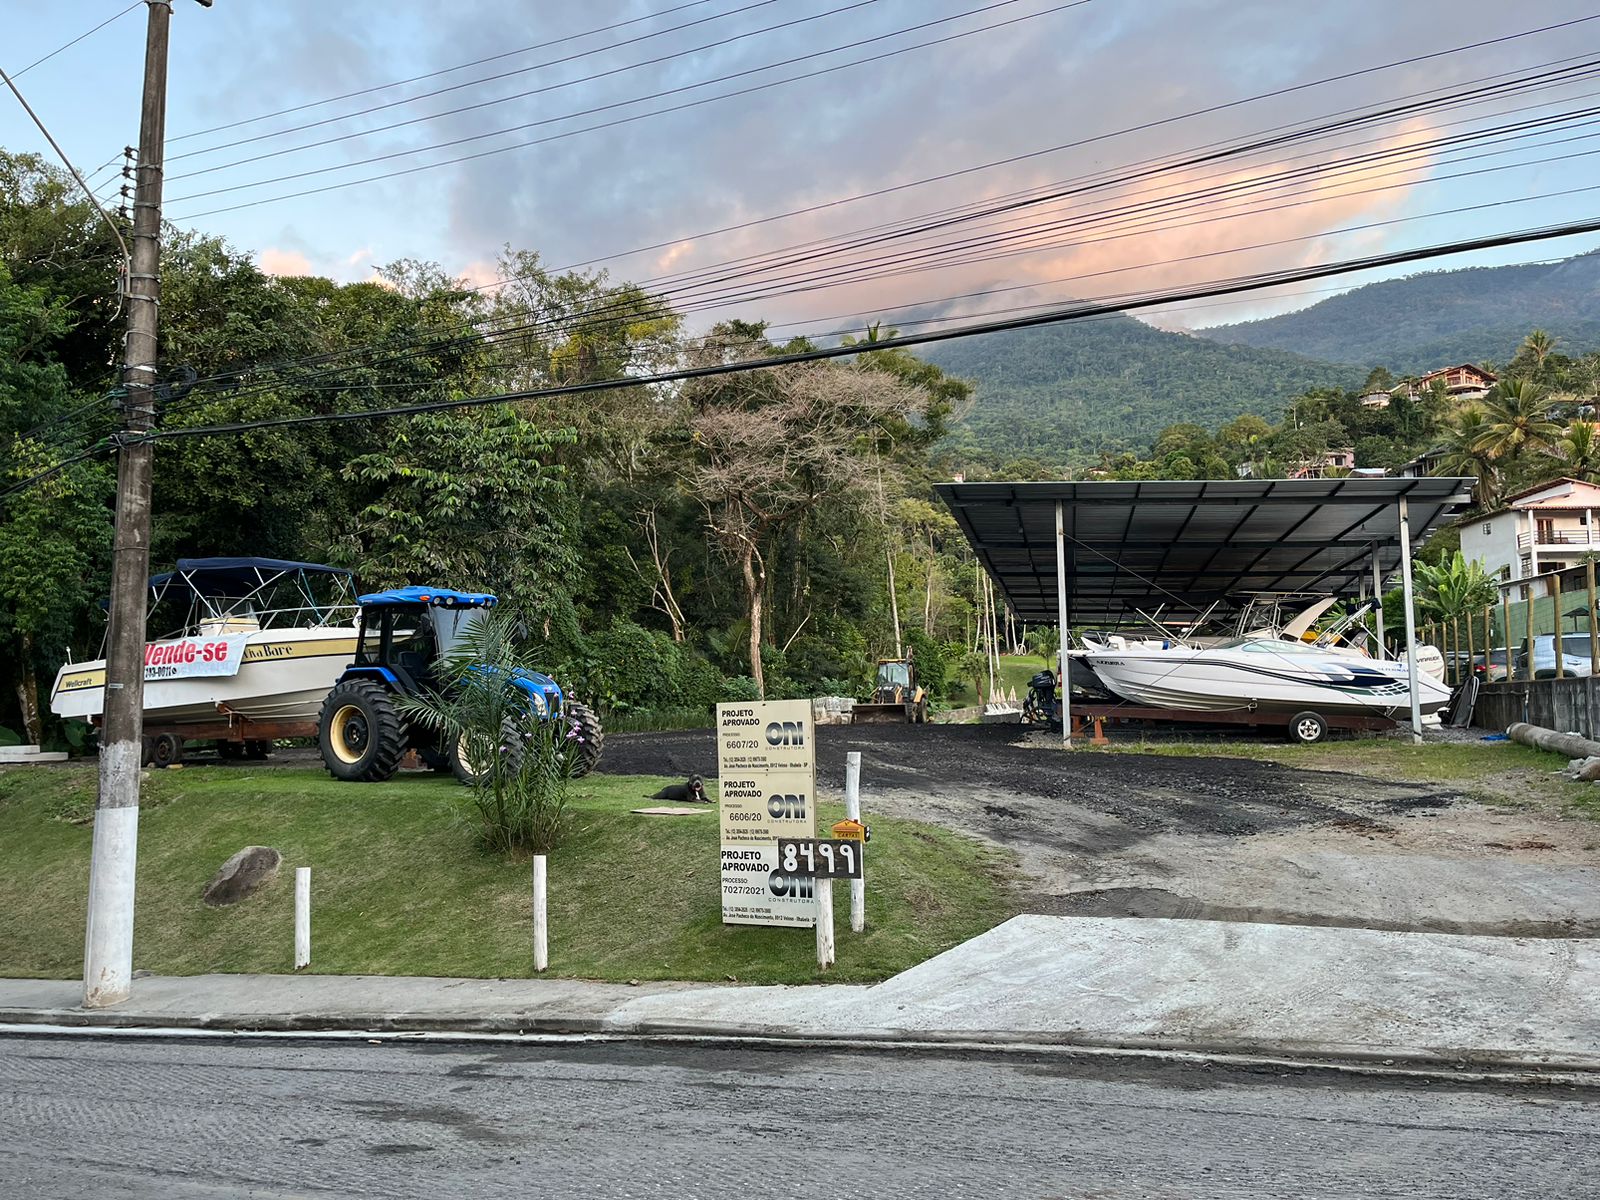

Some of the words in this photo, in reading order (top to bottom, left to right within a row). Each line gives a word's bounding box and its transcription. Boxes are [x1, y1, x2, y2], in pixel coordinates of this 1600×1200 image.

[145, 641, 228, 666] Vende-se
[65, 678, 92, 688] Wellcraft
[722, 710, 754, 718] PROJETO
[722, 718, 760, 727] APROVADO
[765, 721, 804, 746] ONI
[726, 740, 759, 749] 6607/20
[724, 780, 756, 789] PROJETO
[724, 790, 763, 798] APROVADO
[767, 794, 806, 819] ONI
[729, 812, 762, 822] 6606/20
[721, 850, 761, 860] PROJETO
[783, 843, 855, 874] 8499
[722, 862, 770, 873] APROVADO
[723, 886, 765, 895] 7027/2021
